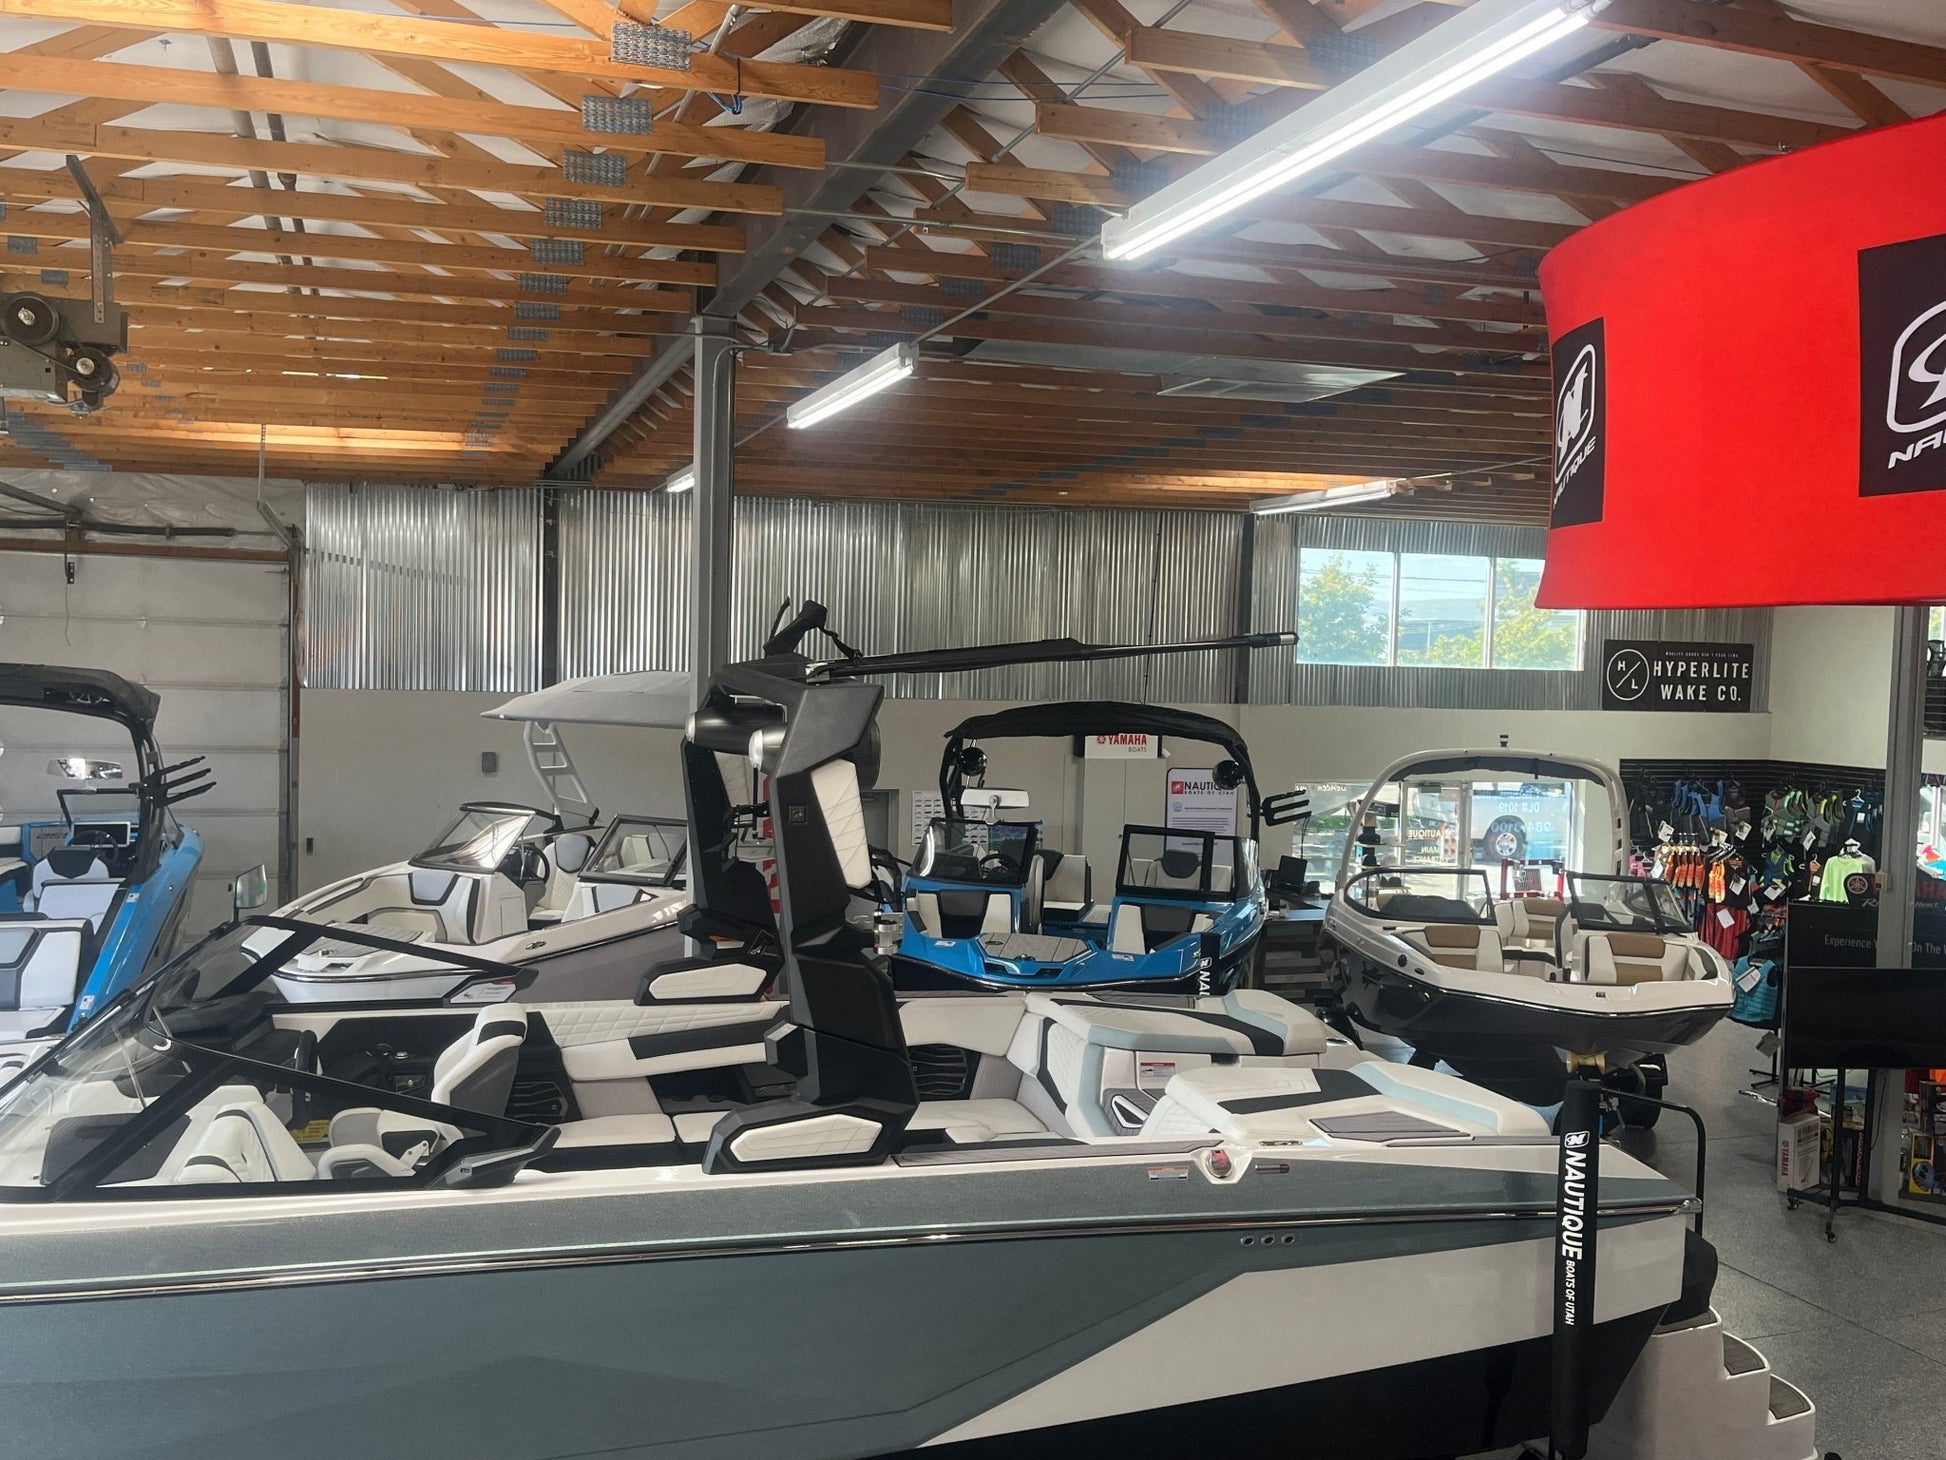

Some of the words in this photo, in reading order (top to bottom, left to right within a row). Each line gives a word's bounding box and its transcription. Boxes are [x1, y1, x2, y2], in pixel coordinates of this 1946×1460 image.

[1888, 429, 1946, 470] NA
[1653, 660, 1750, 679] HYPERLITE
[1660, 684, 1707, 701] WAKE
[1717, 685, 1742, 702] CO.
[1108, 734, 1148, 746] YAMAHA
[1824, 934, 1872, 949] Experience
[1925, 942, 1941, 955] The
[1562, 1150, 1587, 1260] NAUTIQUE
[1565, 1260, 1576, 1288] BOATS
[1565, 1288, 1575, 1302] OF
[1564, 1302, 1575, 1326] UTAH
